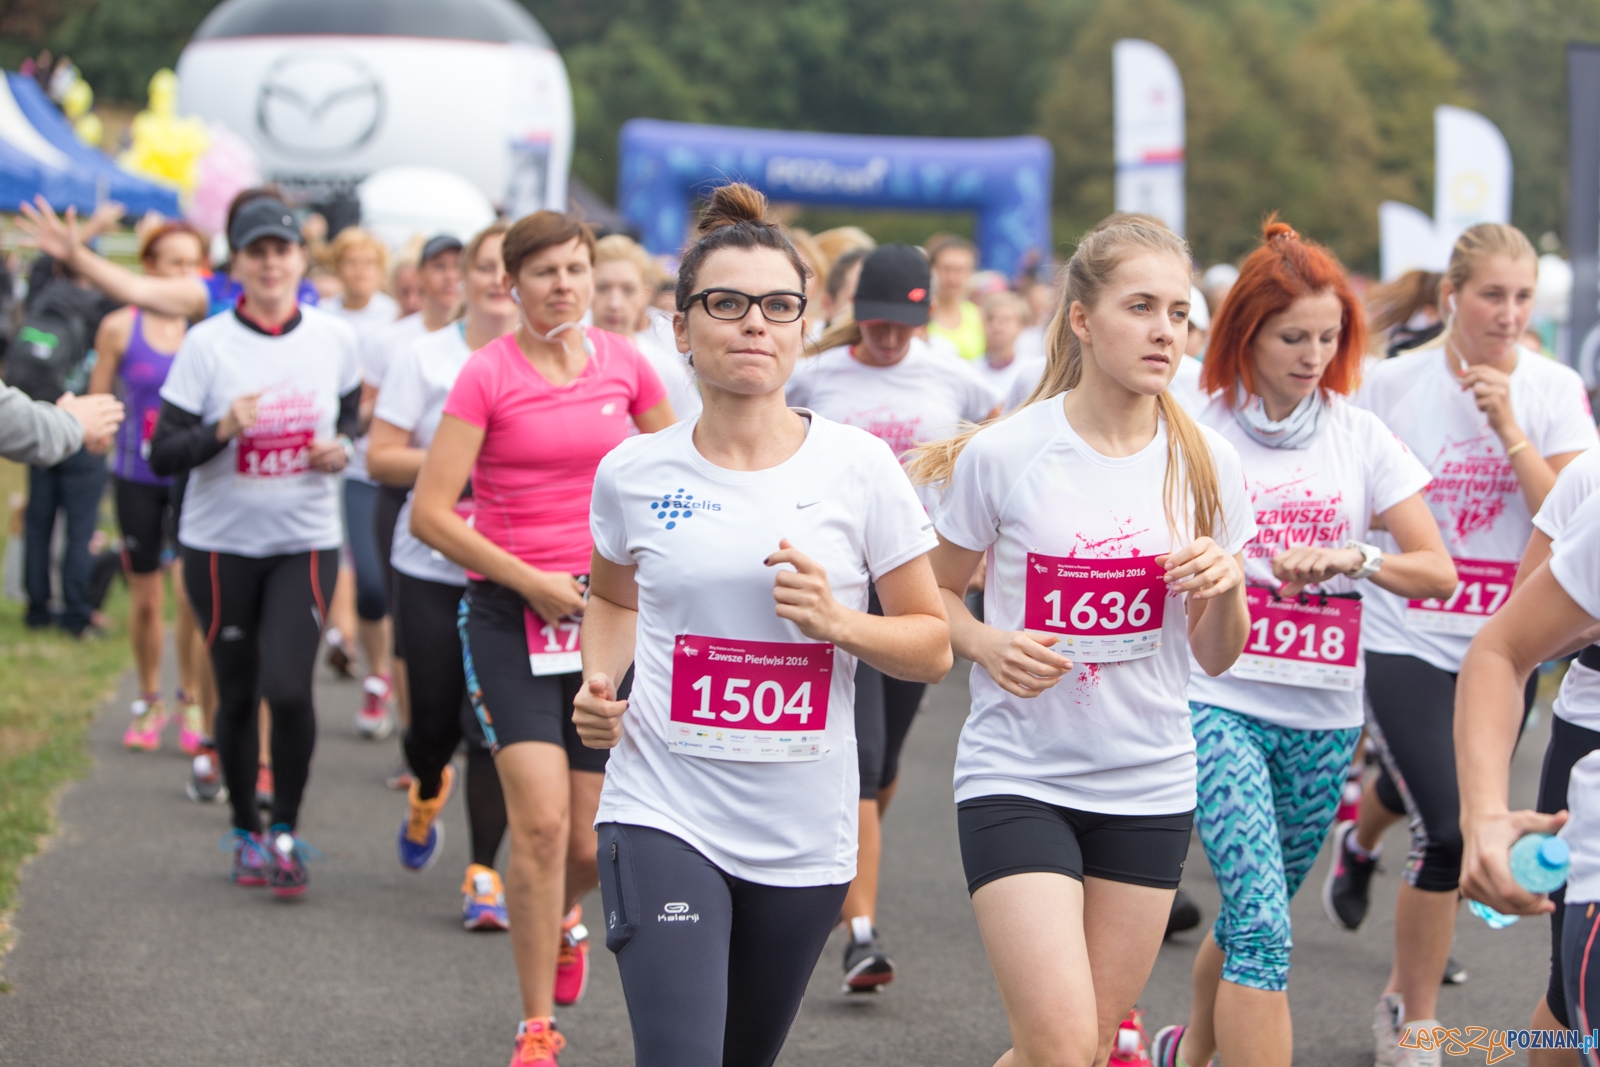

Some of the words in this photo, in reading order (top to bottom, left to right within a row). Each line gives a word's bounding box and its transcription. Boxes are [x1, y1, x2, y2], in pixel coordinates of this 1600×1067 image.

[673, 500, 722, 511] azelis
[1256, 508, 1336, 525] zawsze
[1057, 568, 1088, 578] Zawsze
[1090, 569, 1125, 579] Pier(w)si
[1126, 568, 1146, 577] 2016
[1043, 588, 1151, 630] 1636
[1250, 617, 1345, 661] 1918
[708, 651, 743, 663] Zawsze
[745, 654, 784, 666] Pier(w)si
[785, 656, 809, 666] 2016
[692, 675, 813, 725] 1504
